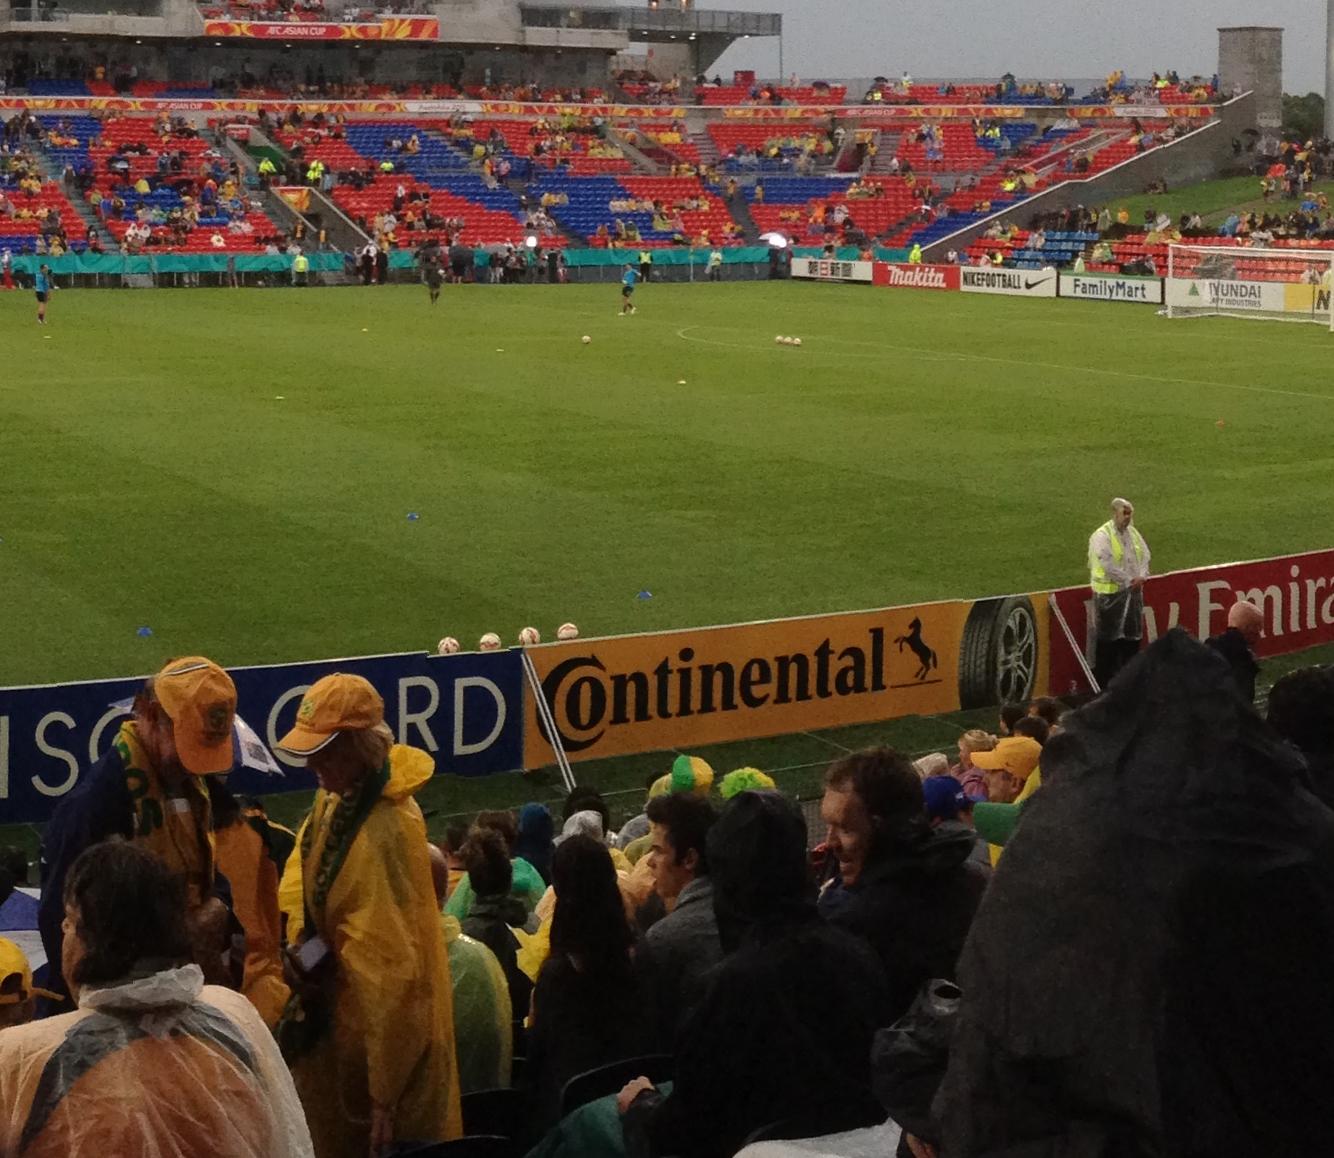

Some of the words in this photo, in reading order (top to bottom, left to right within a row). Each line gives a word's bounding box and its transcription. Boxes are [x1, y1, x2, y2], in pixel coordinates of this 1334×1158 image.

[266, 26, 282, 35] AFC
[282, 26, 308, 35] ASIAN
[309, 27, 326, 35] CUP
[962, 271, 1021, 290] NIKEFOOTBALL
[1073, 278, 1146, 300] FamilyMart
[536, 627, 887, 753] Continental
[267, 677, 507, 768] CRD
